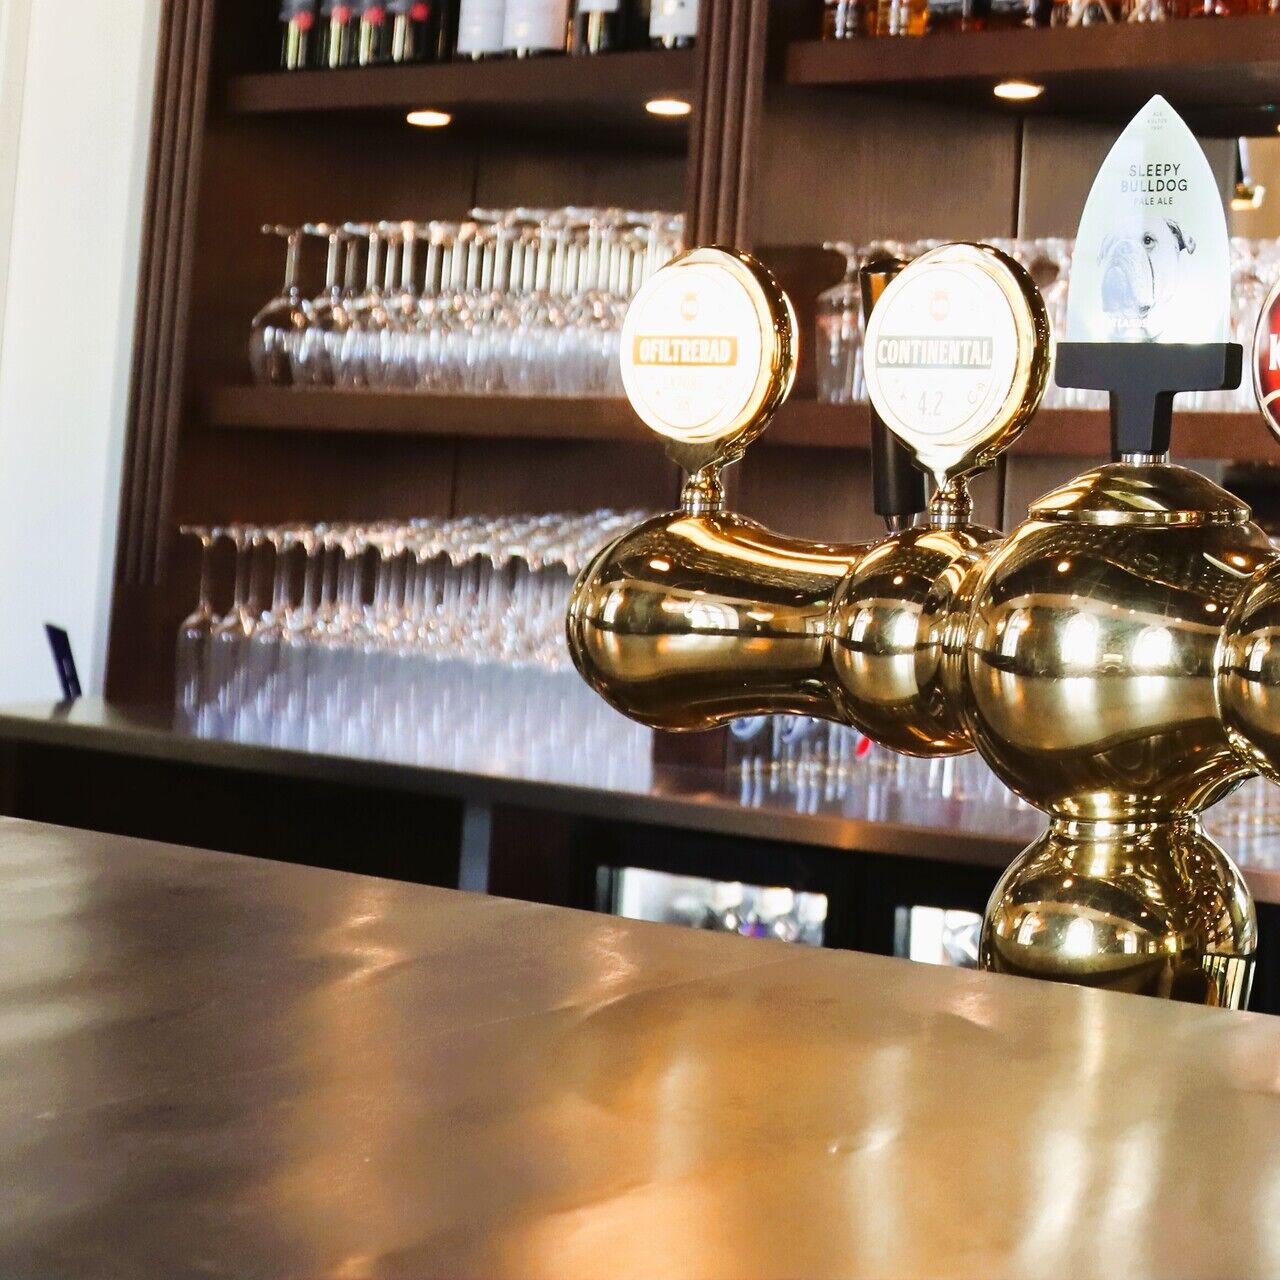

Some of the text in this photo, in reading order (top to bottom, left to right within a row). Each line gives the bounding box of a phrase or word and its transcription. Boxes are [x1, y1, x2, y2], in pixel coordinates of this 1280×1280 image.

[1129, 164, 1181, 177] SLEEPY
[1121, 179, 1188, 192] BULLDOG
[1157, 197, 1173, 205] ALE
[639, 338, 731, 364] OFILTRERAD
[877, 337, 993, 366] CONTINENTAL
[918, 391, 944, 416] 4.2
